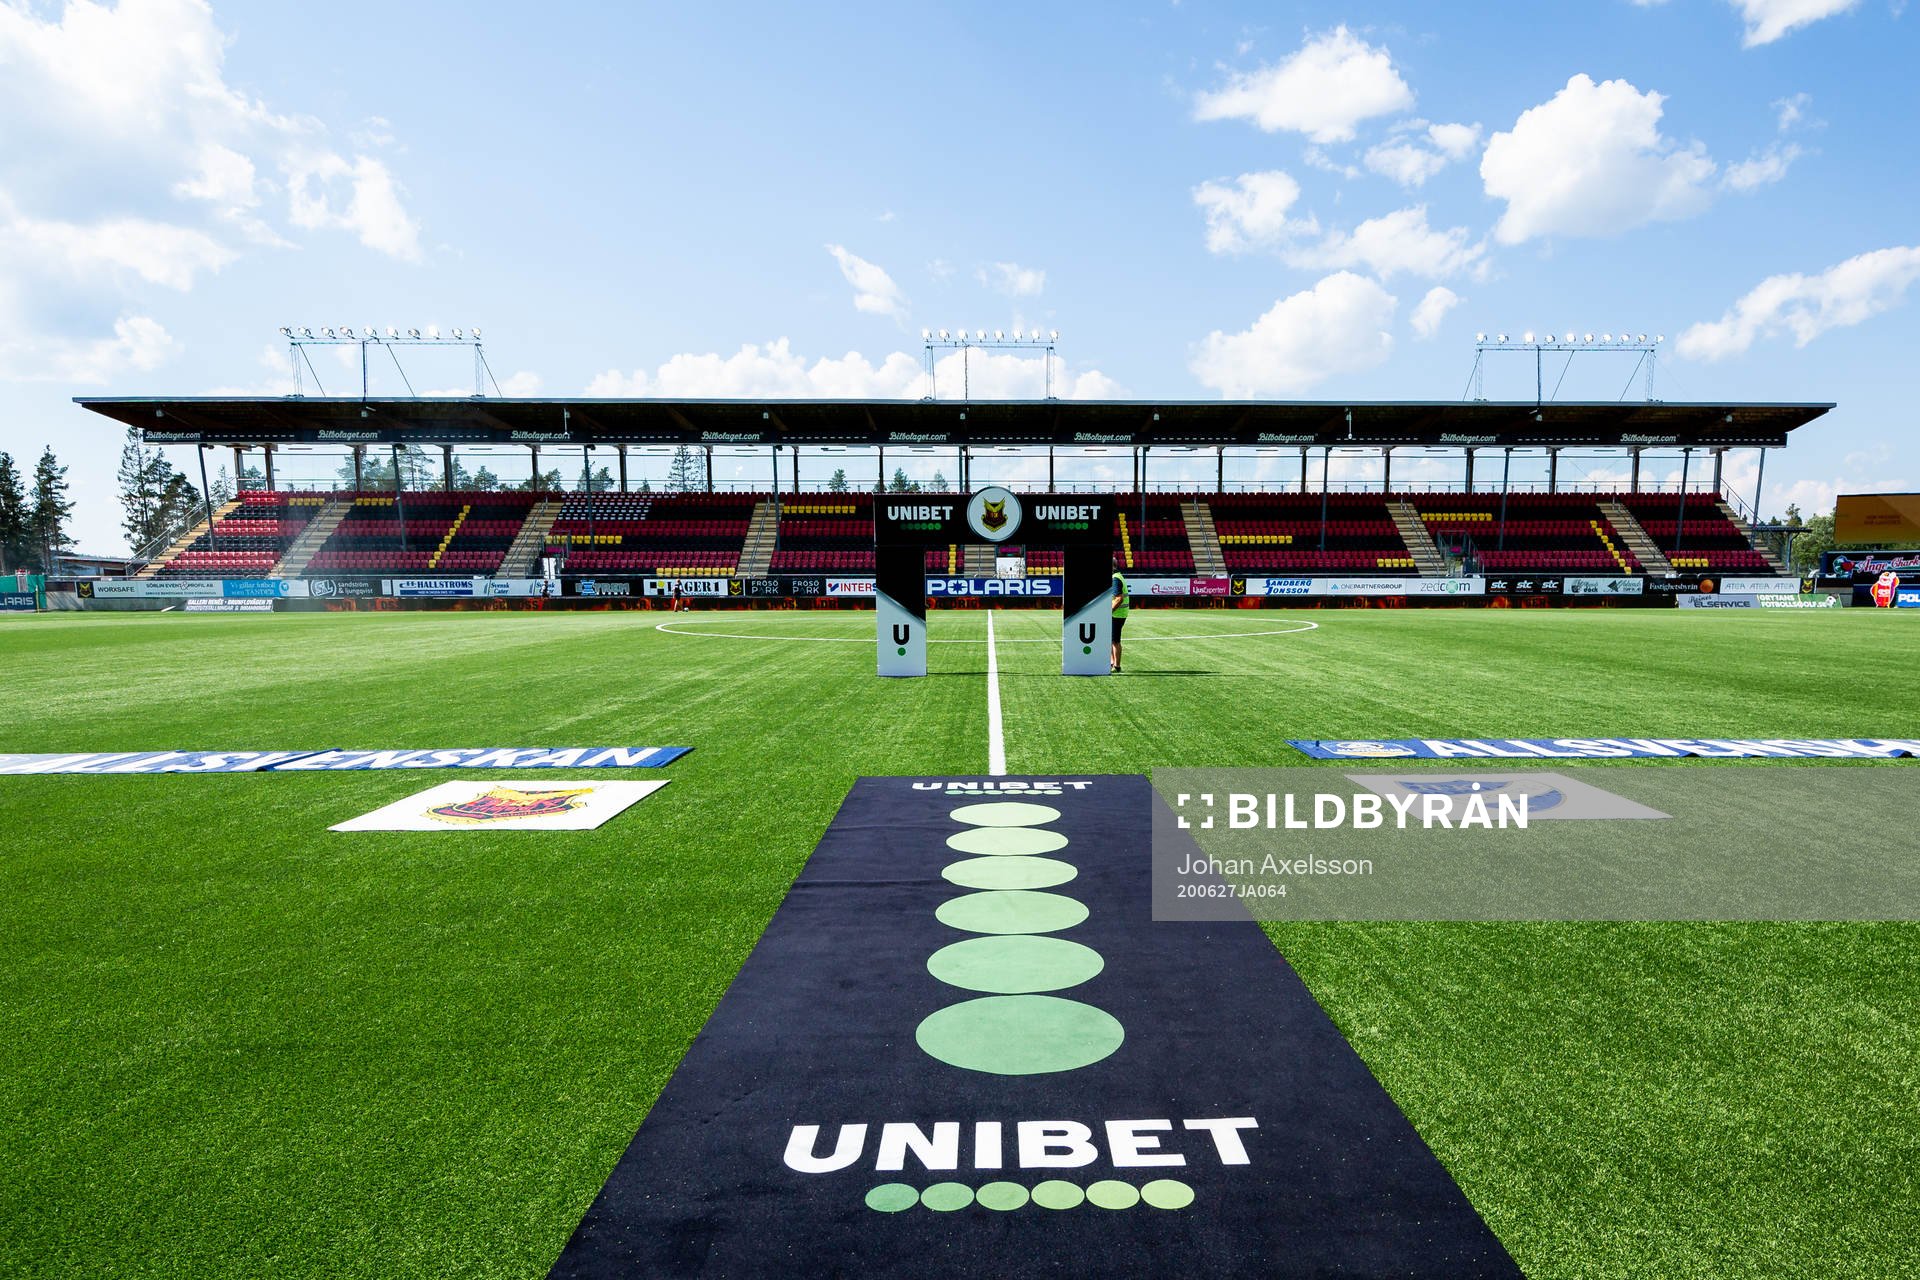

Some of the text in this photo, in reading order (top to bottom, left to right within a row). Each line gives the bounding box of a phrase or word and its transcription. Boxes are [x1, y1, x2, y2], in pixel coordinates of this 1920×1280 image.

[887, 506, 953, 521] UNIBET
[1035, 505, 1101, 520] UNIBET
[927, 579, 1051, 595] POLARIS
[0, 597, 34, 606] ARIS
[1694, 600, 1751, 608] ELSERVICE
[893, 624, 910, 645] U
[1079, 623, 1096, 644] U
[911, 781, 1093, 790] UNIBET
[783, 1117, 1259, 1173] UNIBET
